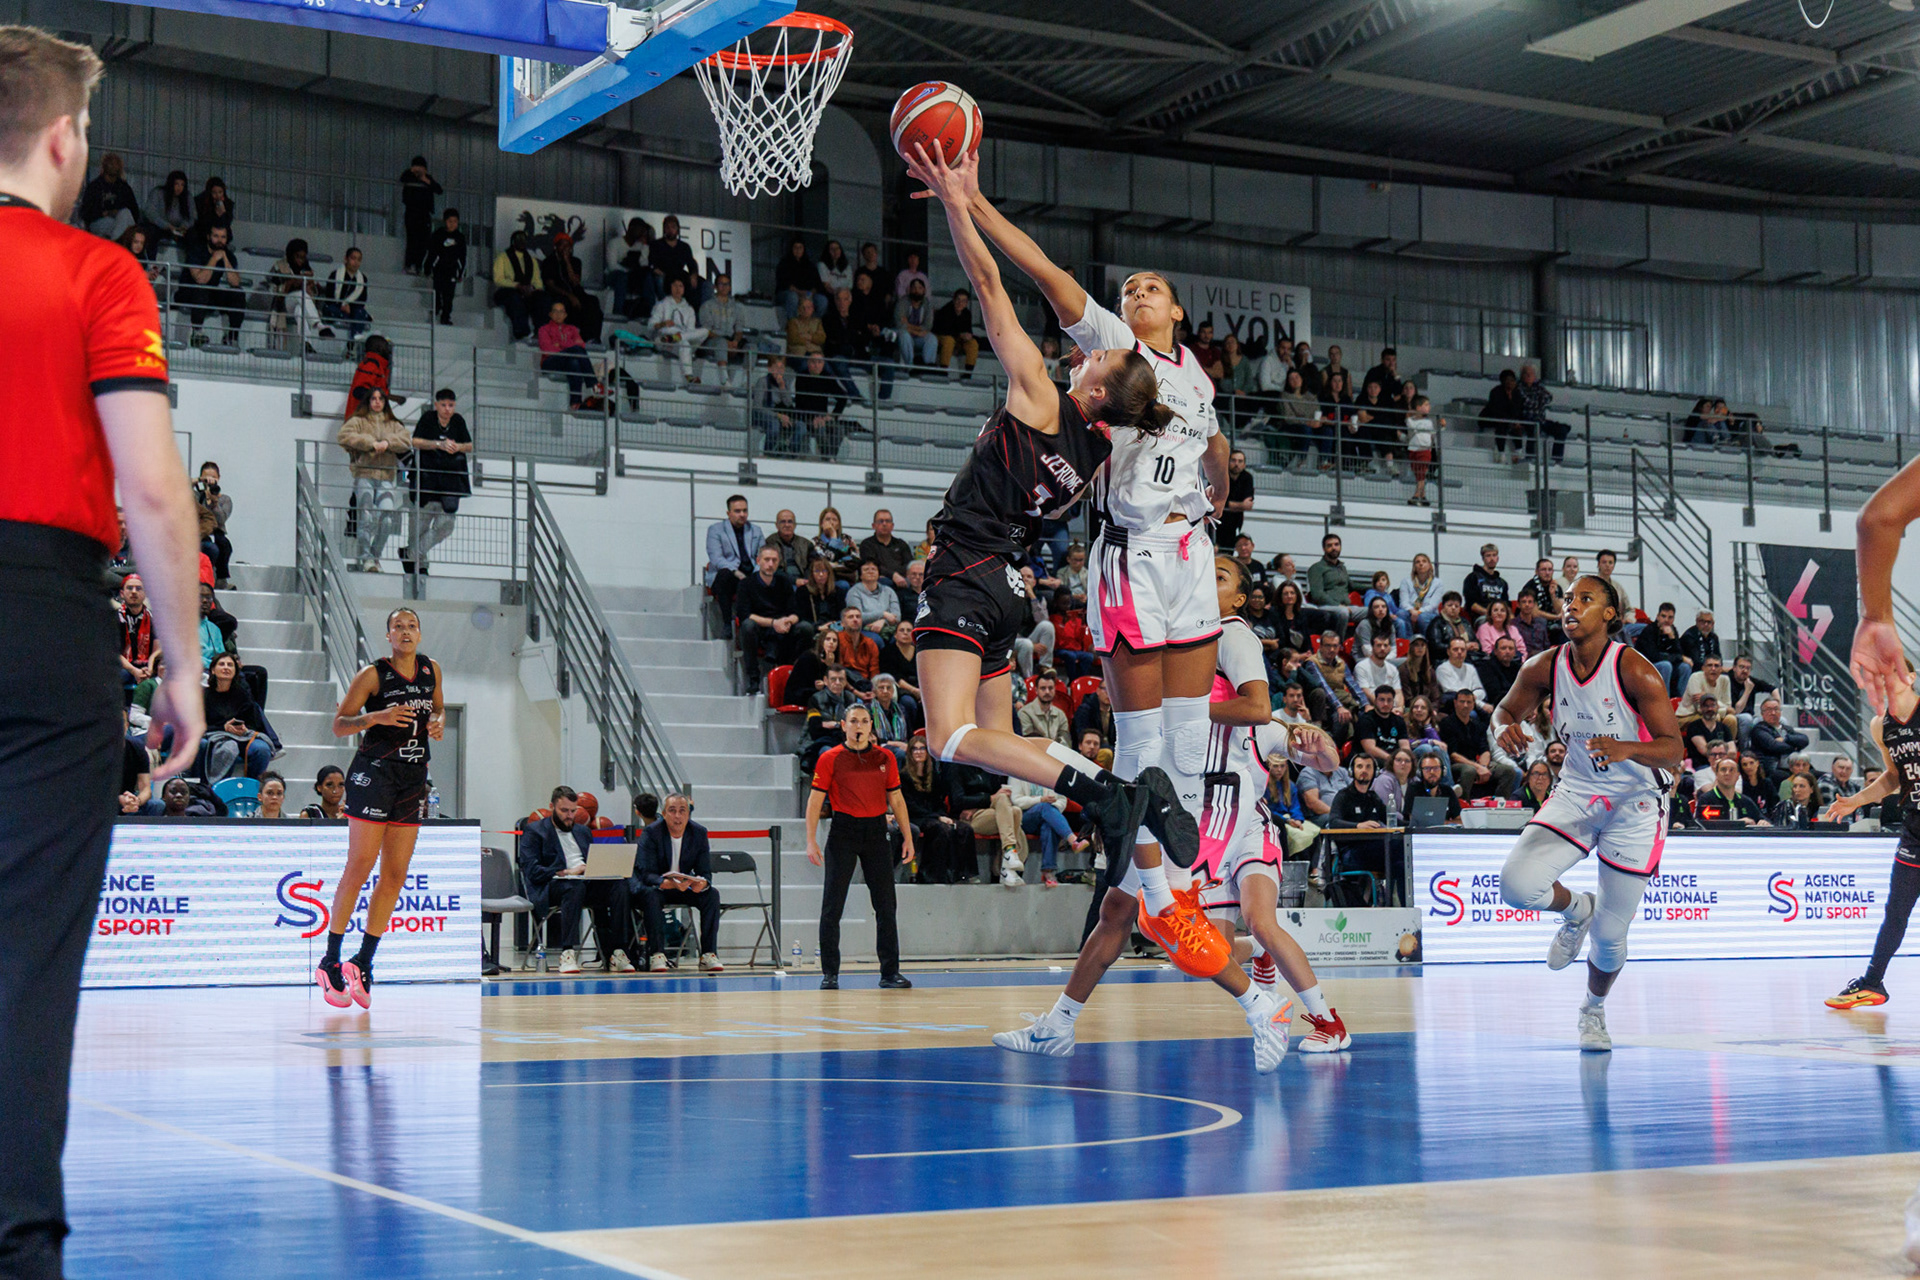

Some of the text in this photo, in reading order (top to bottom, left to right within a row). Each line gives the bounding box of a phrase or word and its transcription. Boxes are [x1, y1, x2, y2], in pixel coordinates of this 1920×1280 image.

[701, 228, 732, 252] DE
[1205, 285, 1295, 315] VILLE DE
[1153, 454, 1175, 485] 10
[1793, 673, 1834, 693] DLC
[1572, 731, 1591, 739] LDLC
[1471, 874, 1500, 888] AGE
[1804, 874, 1856, 887] AGENCE
[1643, 891, 1718, 904] NATIONALE
[1805, 890, 1875, 903] NATIONALE
[101, 897, 190, 914] IONALE
[1472, 909, 1542, 922] DU SPORT
[1644, 908, 1710, 921] DU SPORT
[1805, 906, 1868, 919] DU SPORT
[98, 919, 175, 936] SPORT
[1318, 932, 1372, 943] AGG PRINT
